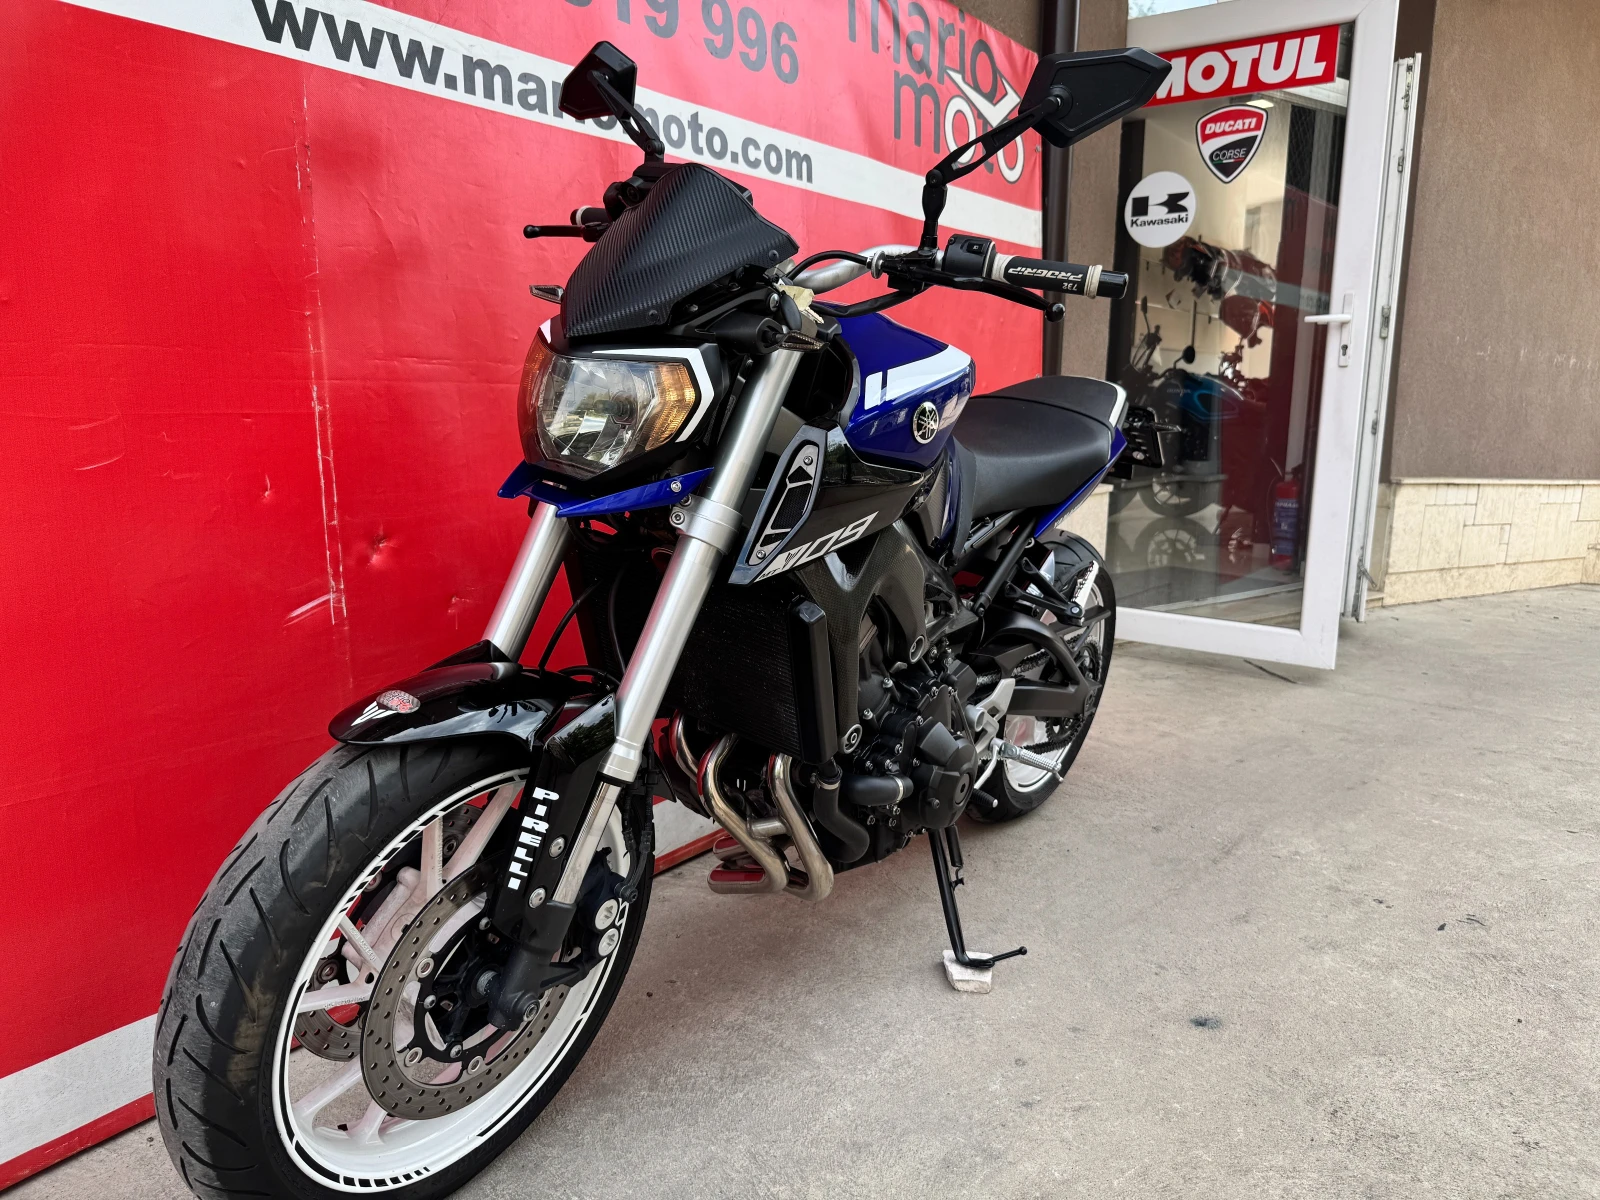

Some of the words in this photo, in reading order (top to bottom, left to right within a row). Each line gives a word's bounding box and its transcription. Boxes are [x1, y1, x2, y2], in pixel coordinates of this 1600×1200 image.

[701, 0, 799, 84] 996
[1155, 34, 1327, 100] MOTUL
[252, 0, 813, 184] www.marmoto.com
[1205, 117, 1257, 135] DUCATI
[1212, 147, 1248, 161] CORSE
[1130, 213, 1189, 228] Kawasaki
[1062, 282, 1078, 291] 732
